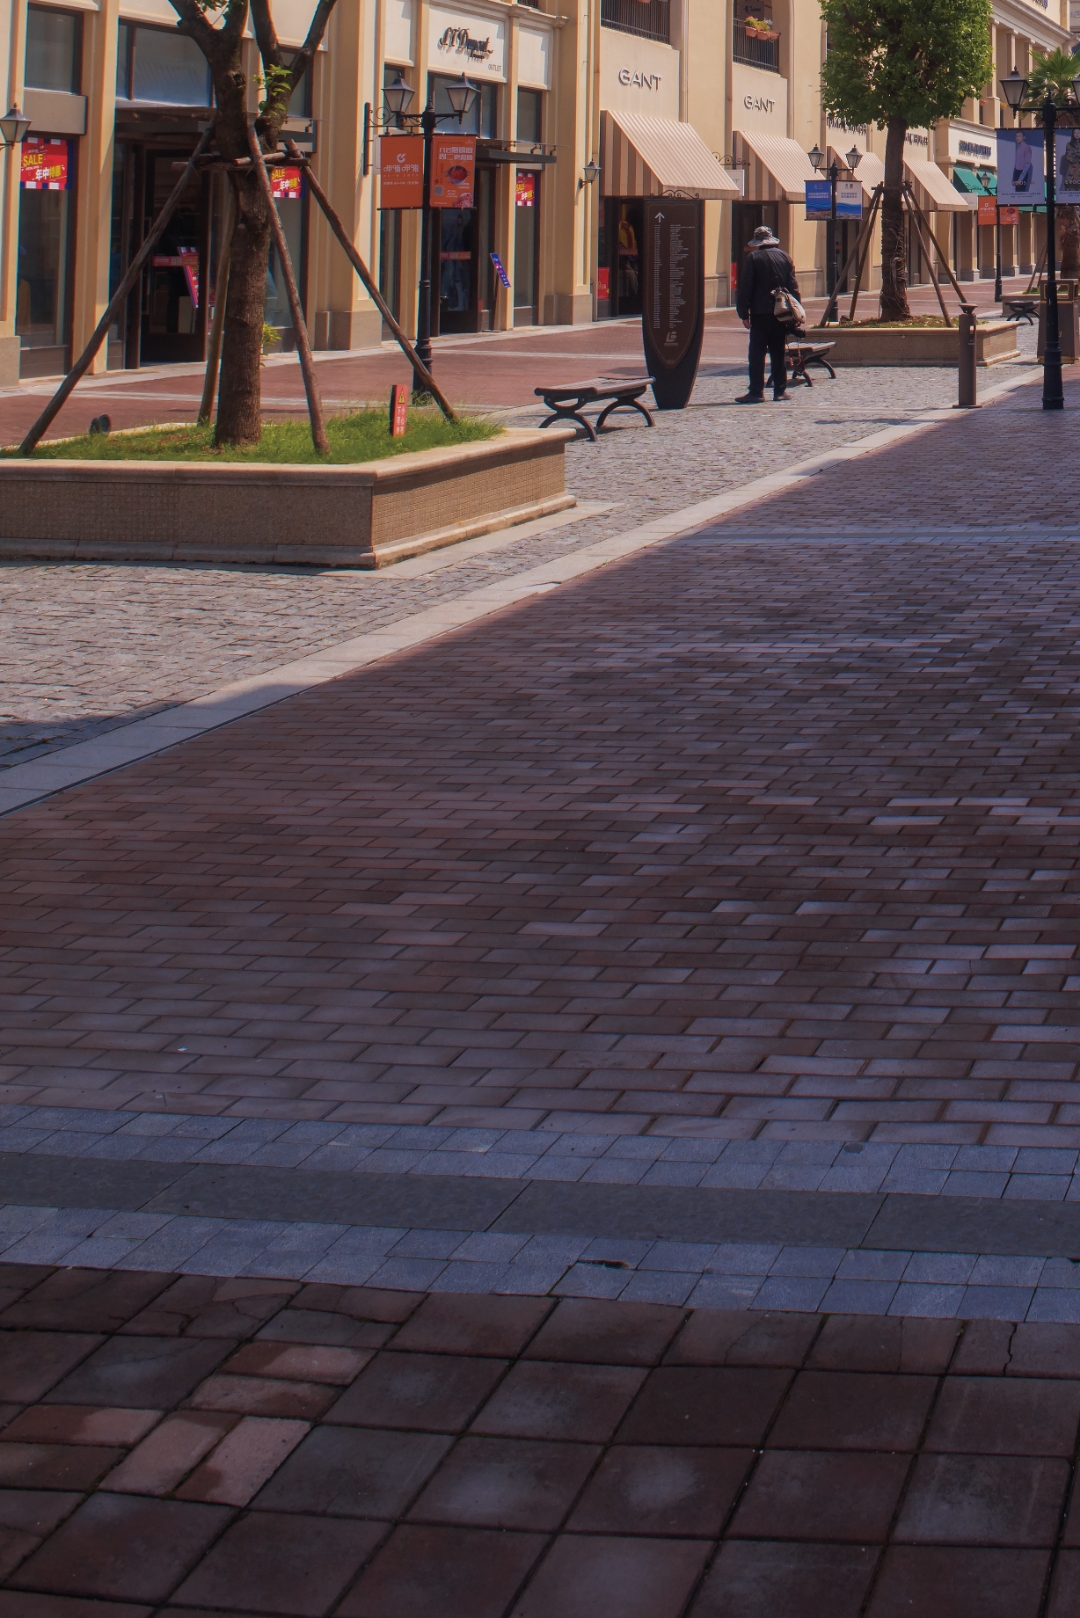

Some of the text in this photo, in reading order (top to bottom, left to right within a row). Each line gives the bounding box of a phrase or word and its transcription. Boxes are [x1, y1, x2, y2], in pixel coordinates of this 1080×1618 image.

[618, 67, 662, 92] GANT
[743, 94, 776, 114] GANT
[23, 153, 43, 167] SALE
